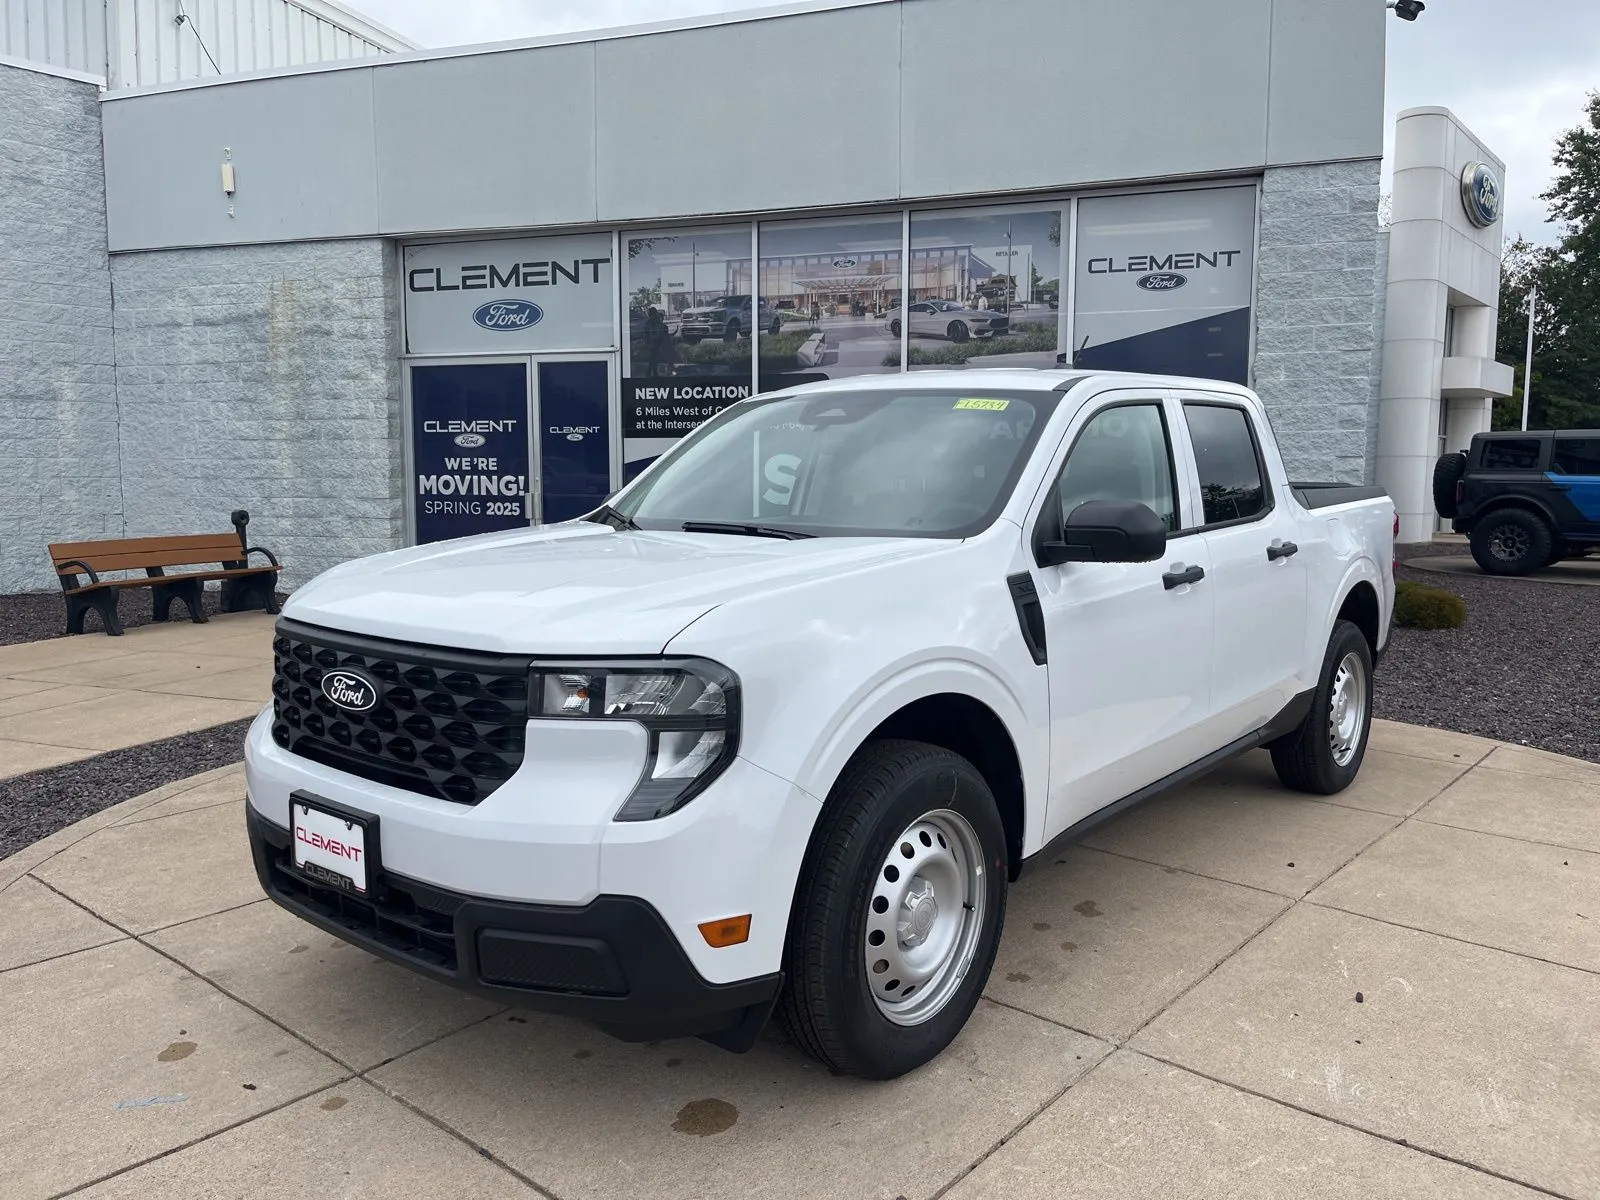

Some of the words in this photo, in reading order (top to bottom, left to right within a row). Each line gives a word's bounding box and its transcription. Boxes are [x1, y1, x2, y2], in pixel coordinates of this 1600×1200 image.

[1088, 250, 1241, 274] CLEMENT
[409, 258, 611, 293] CLEMENT
[485, 304, 530, 326] Ford
[635, 387, 670, 400] NEW
[673, 385, 749, 399] LOCATION
[635, 407, 643, 416] 6
[645, 406, 670, 416] Miles
[673, 406, 699, 416] West
[701, 405, 713, 416] of
[424, 420, 517, 433] CLEMENT
[549, 426, 601, 434] CLEMENT
[635, 420, 645, 429] at
[647, 419, 663, 429] the
[444, 457, 498, 471] WE'RE
[419, 474, 526, 496] MOVING!
[425, 500, 481, 515] SPRING
[486, 501, 521, 516] 2025
[331, 676, 365, 706] Ford
[296, 826, 362, 862] CLEMENT
[305, 863, 353, 890] CLEMENT
